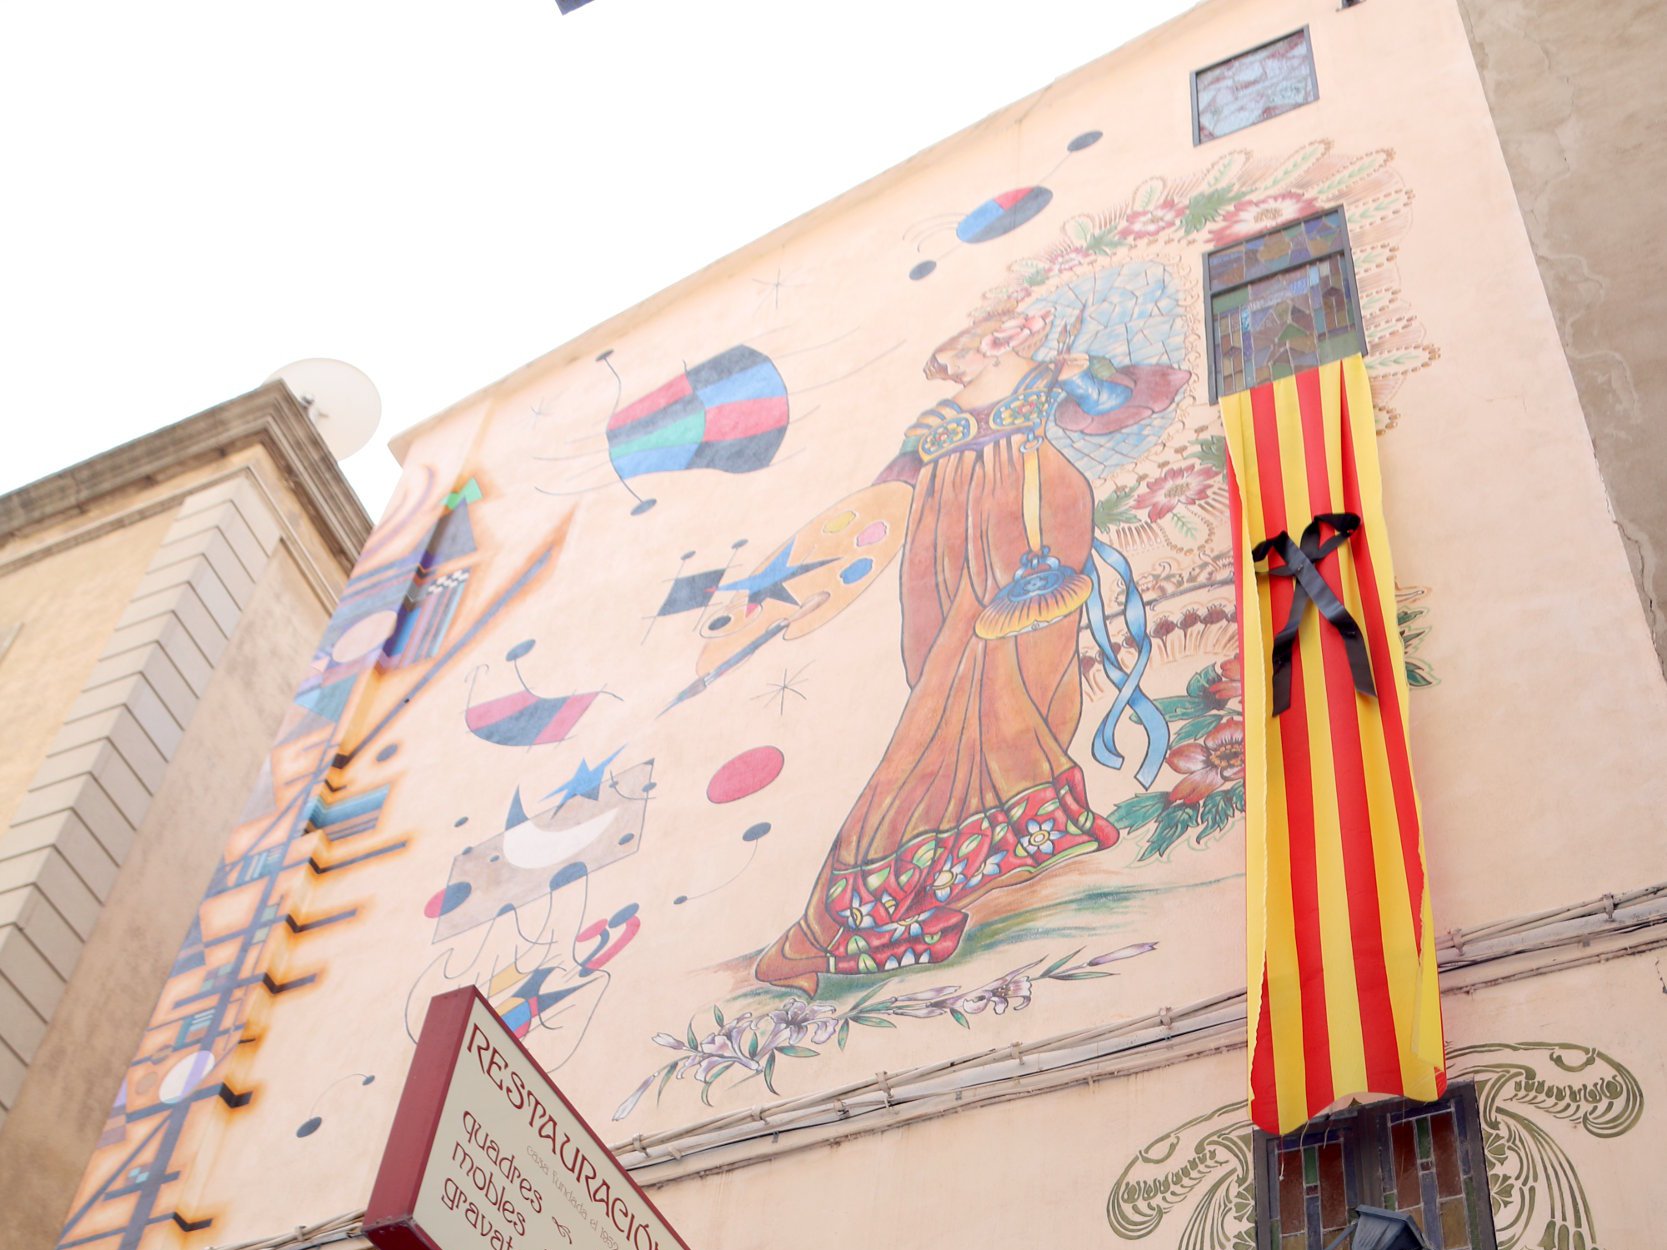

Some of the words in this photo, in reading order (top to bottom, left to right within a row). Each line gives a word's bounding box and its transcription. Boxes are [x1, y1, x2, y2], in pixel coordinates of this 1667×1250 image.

[452, 1140, 526, 1237] mobles
[462, 1110, 543, 1214] quadres
[527, 1145, 549, 1176] casa
[552, 1170, 588, 1220] fundada
[590, 1218, 599, 1232] el
